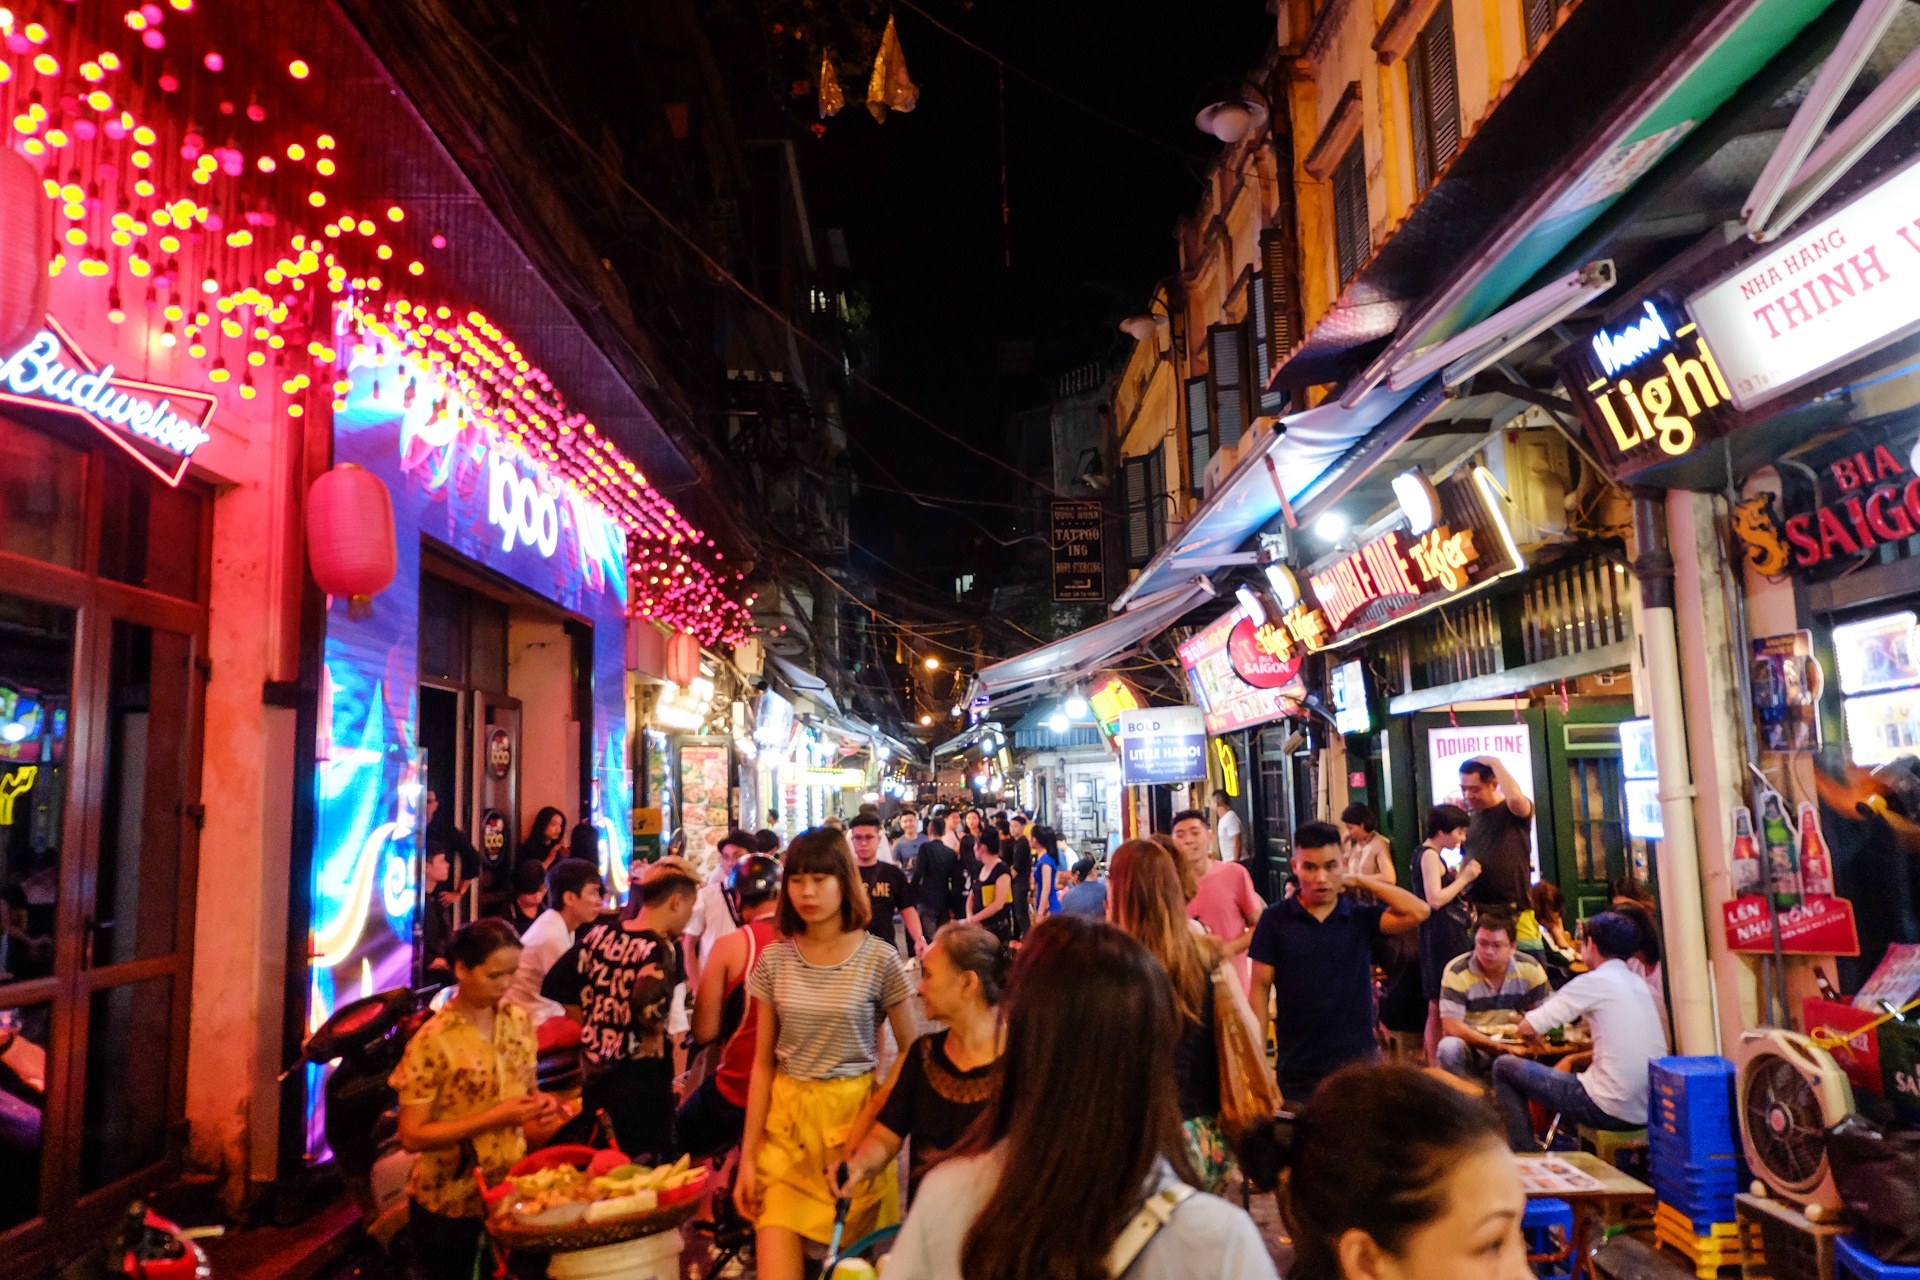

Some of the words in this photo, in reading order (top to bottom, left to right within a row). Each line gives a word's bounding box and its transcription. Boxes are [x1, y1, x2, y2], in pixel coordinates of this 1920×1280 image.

[0, 330, 210, 455] Budweiser
[1595, 336, 1732, 456] Light
[1831, 444, 1905, 492] BIA
[488, 449, 559, 558] 1900
[1055, 529, 1099, 540] TATTOO
[1068, 544, 1088, 556] ING
[1408, 528, 1470, 592] Tiger
[1309, 552, 1378, 633] DOUBLE
[1361, 531, 1420, 597] ONE
[1254, 623, 1291, 663] Tiger
[1282, 606, 1321, 651] Tiger
[1243, 662, 1290, 675] SAIGON
[1258, 655, 1274, 663] BIA
[1128, 722, 1160, 732] BOLD
[1436, 736, 1490, 759] DOUBLE
[1494, 735, 1524, 754] ONE
[1129, 747, 1160, 761] LITTLE
[1162, 745, 1201, 759] HANOI
